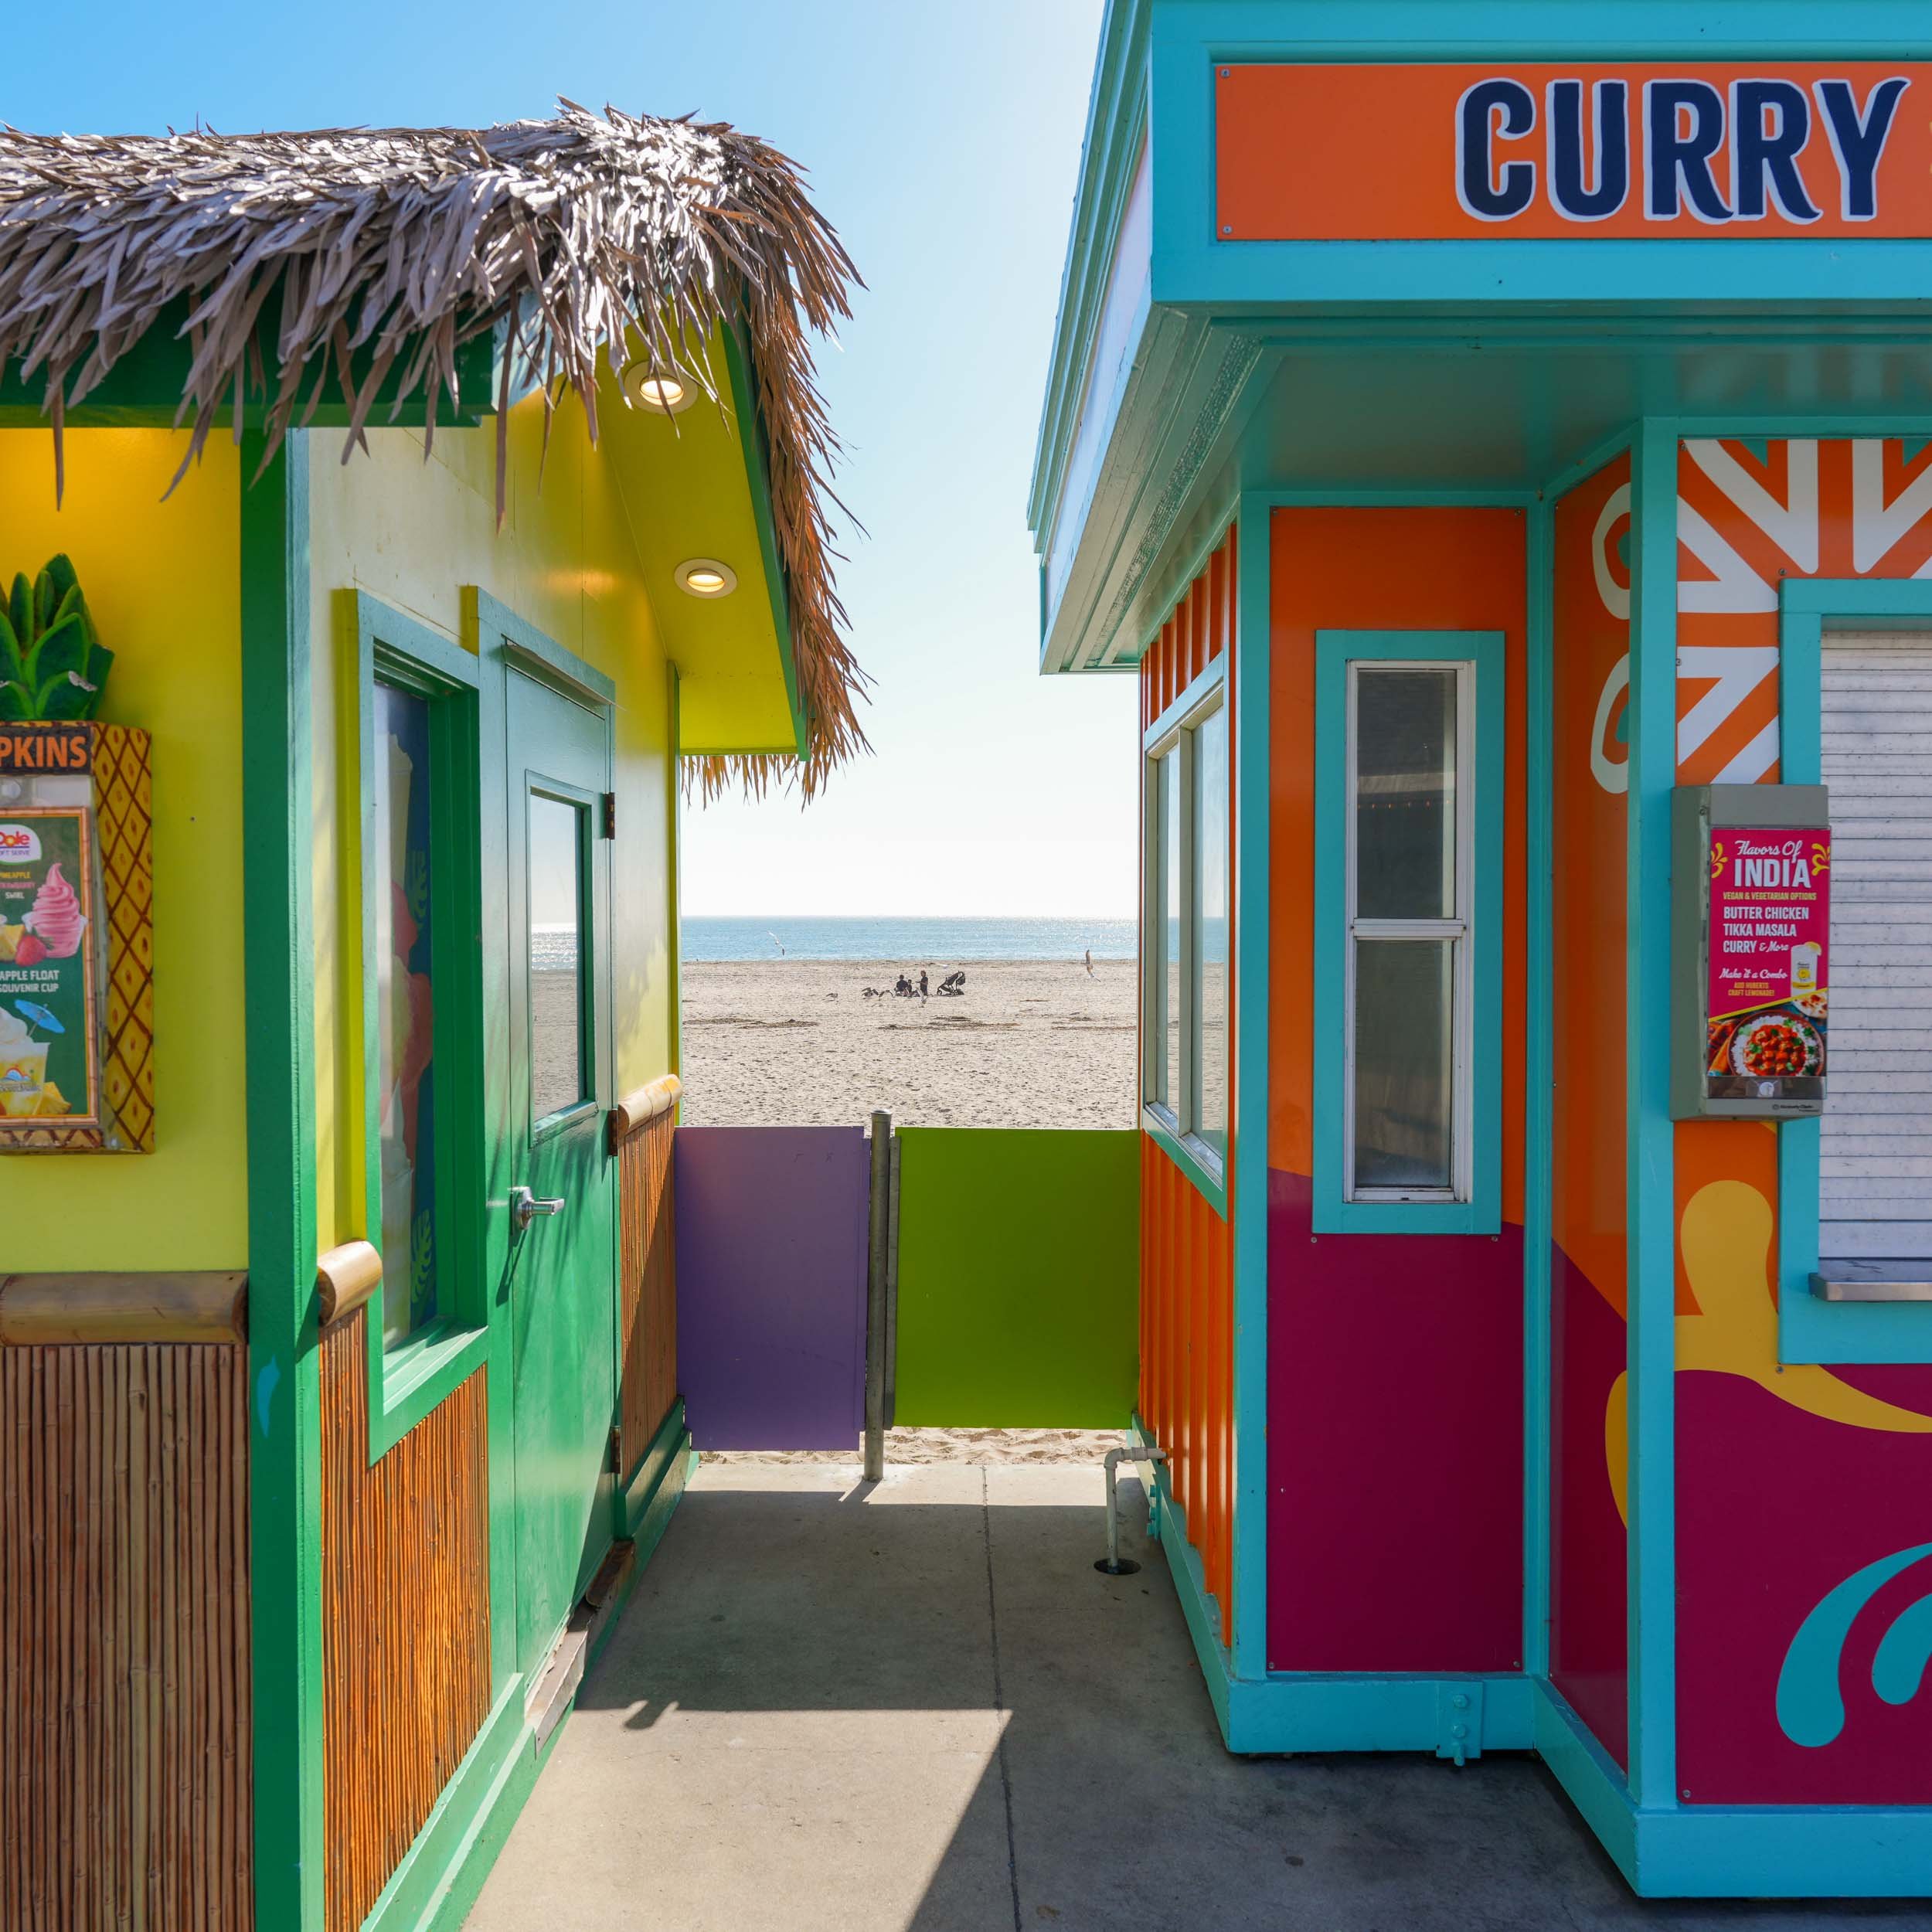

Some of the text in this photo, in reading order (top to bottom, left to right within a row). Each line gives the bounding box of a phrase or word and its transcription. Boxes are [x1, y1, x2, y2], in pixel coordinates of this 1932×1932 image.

[1455, 76, 1911, 225] CURRY
[1734, 840, 1802, 863] Flavors Of
[1734, 859, 1811, 888] INDIA
[1751, 892, 1789, 900] VEGETARIAN
[1723, 906, 1809, 920] BUTTER CHICKEN
[1723, 923, 1797, 937] TIKKA MASALA
[1723, 940, 1789, 954] CURRY & More
[30, 970, 60, 981] FLOAT
[1719, 968, 1742, 979] Make
[1760, 968, 1787, 979] Combo
[41, 983, 60, 993] CUP
